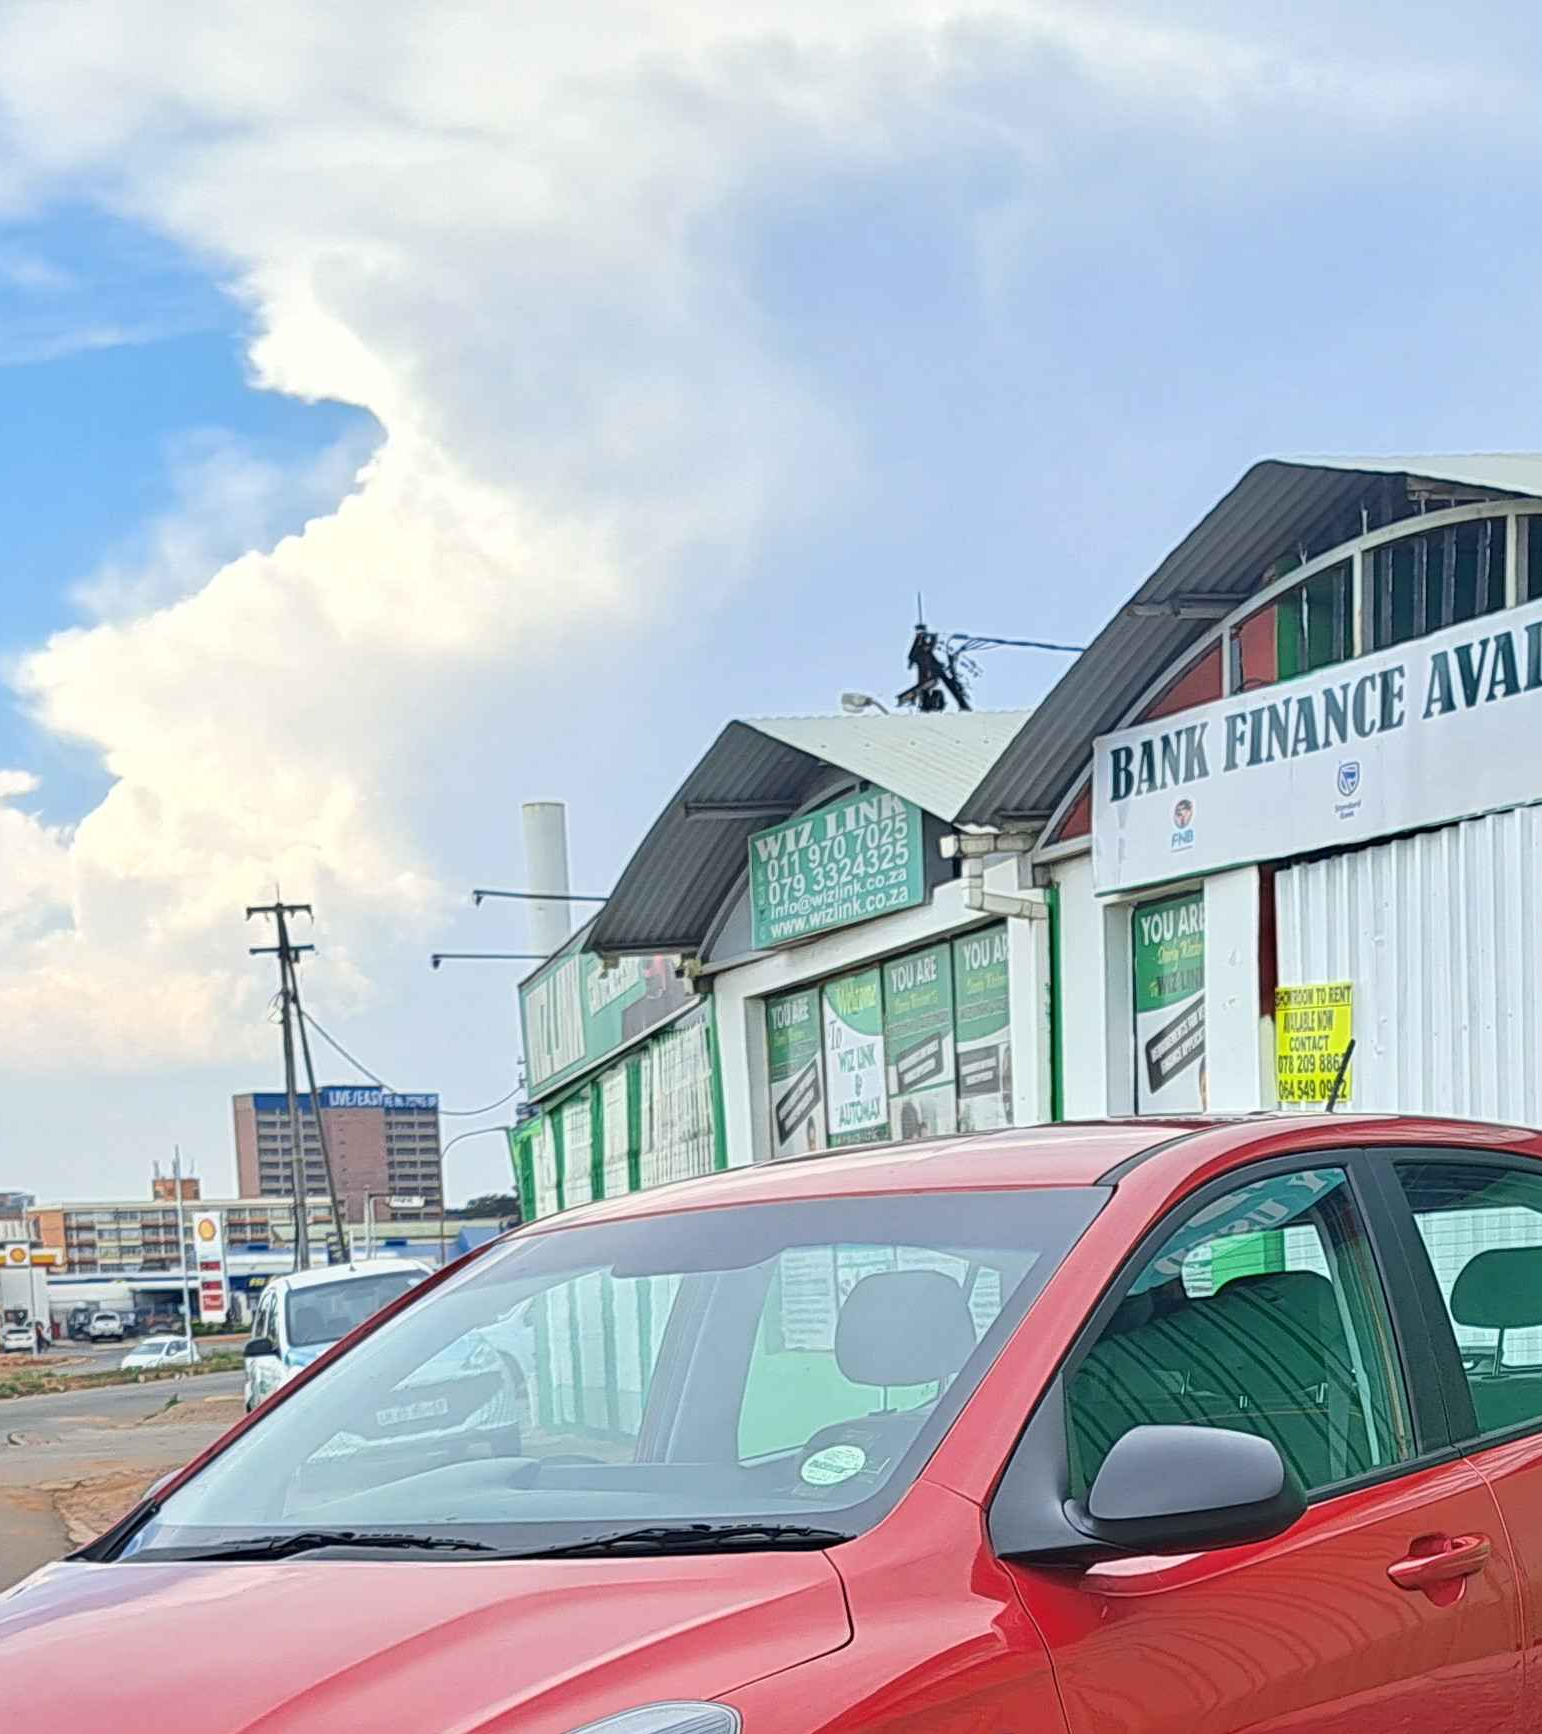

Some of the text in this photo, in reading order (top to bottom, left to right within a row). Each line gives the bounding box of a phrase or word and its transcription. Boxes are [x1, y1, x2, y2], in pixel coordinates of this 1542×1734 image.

[1109, 724, 1211, 802] BANK
[1223, 664, 1406, 775] FINANCE
[755, 792, 907, 863] WIZ LINK
[1171, 829, 1194, 849] FNB
[767, 813, 908, 882] 011 970 7025
[768, 873, 806, 905] 079
[812, 839, 909, 891] 3324325
[770, 886, 909, 938] www.wizlink.co.za
[1140, 909, 1174, 946] YOU
[891, 965, 916, 993] YOU
[917, 955, 937, 984] ARE
[963, 940, 990, 971] YOU
[1315, 987, 1327, 1004] TO
[1328, 985, 1352, 1004] RENT
[771, 1006, 791, 1030] YOU
[1289, 1034, 1330, 1052] CONTACT
[1297, 1054, 1316, 1074] 209
[1319, 1053, 1346, 1073] 886
